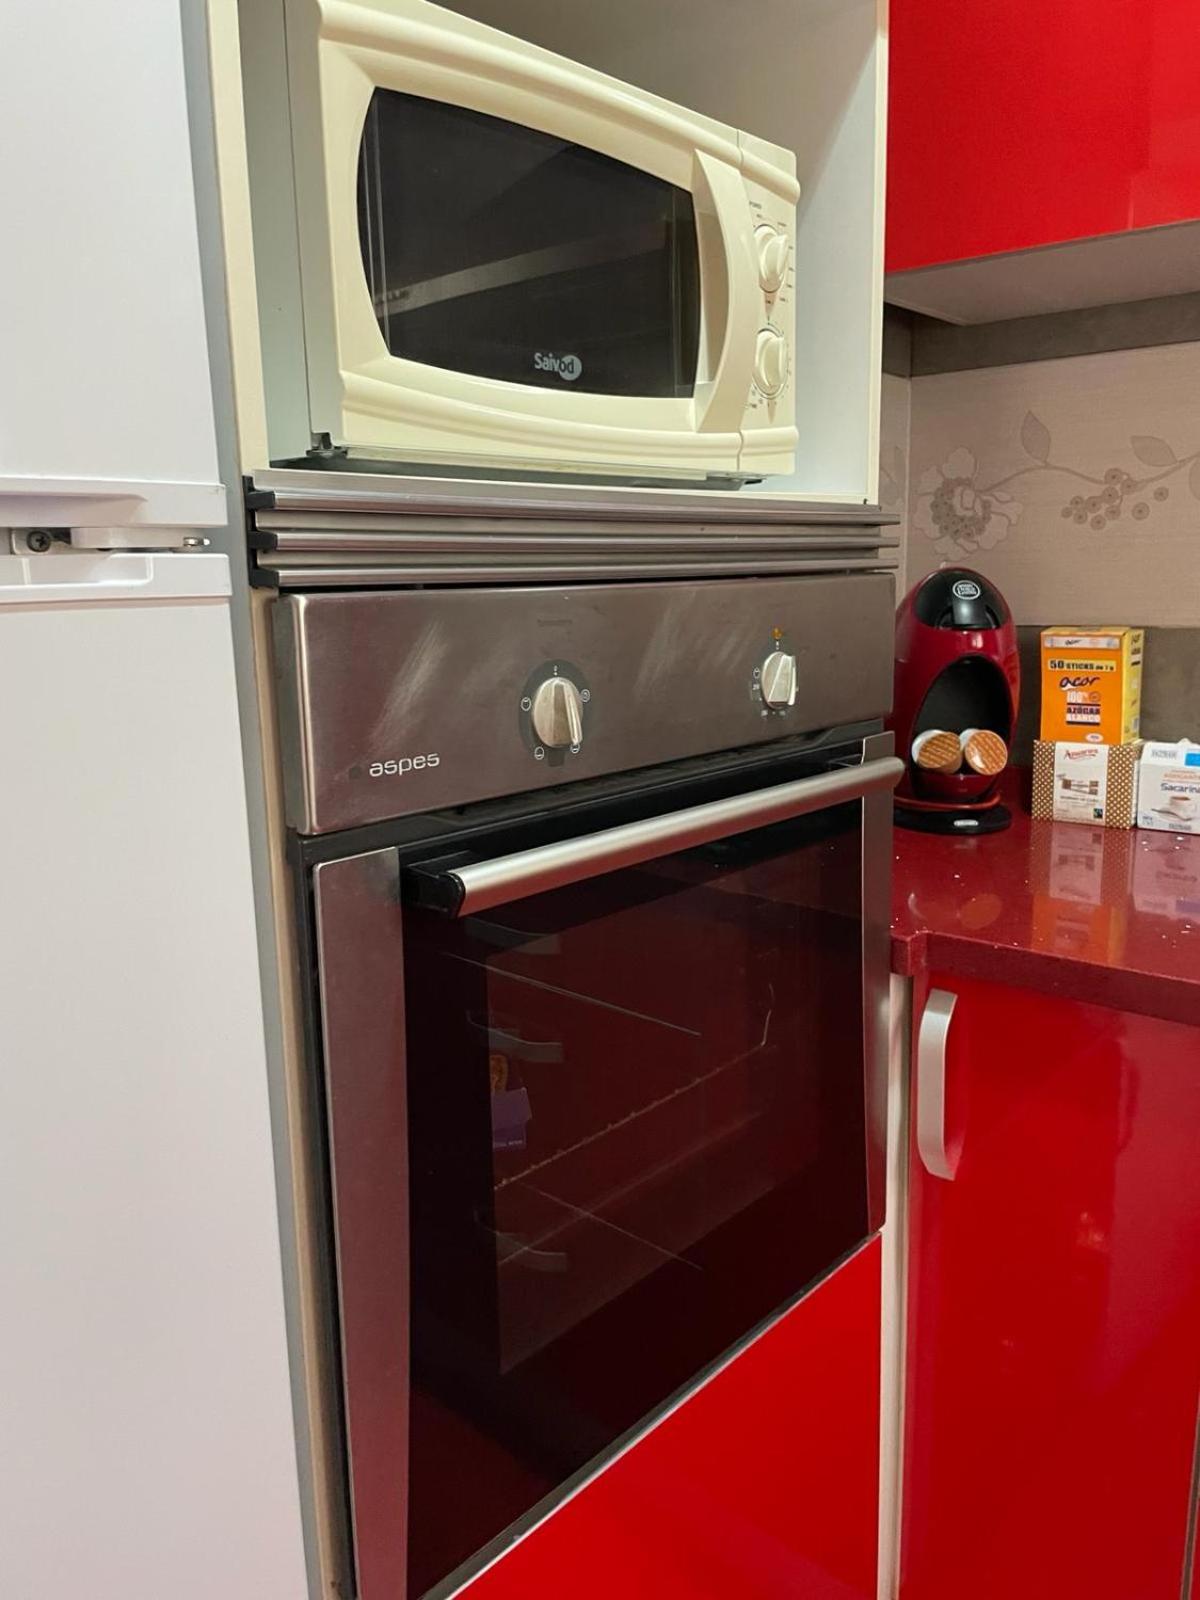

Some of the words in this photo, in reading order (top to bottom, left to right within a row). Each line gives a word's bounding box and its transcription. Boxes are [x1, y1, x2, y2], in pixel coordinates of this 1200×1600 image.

[534, 352, 576, 375] Saivod
[1050, 659, 1065, 669] 50
[1066, 662, 1094, 670] STICKS
[1059, 675, 1101, 688] acor
[369, 753, 440, 777] aspes
